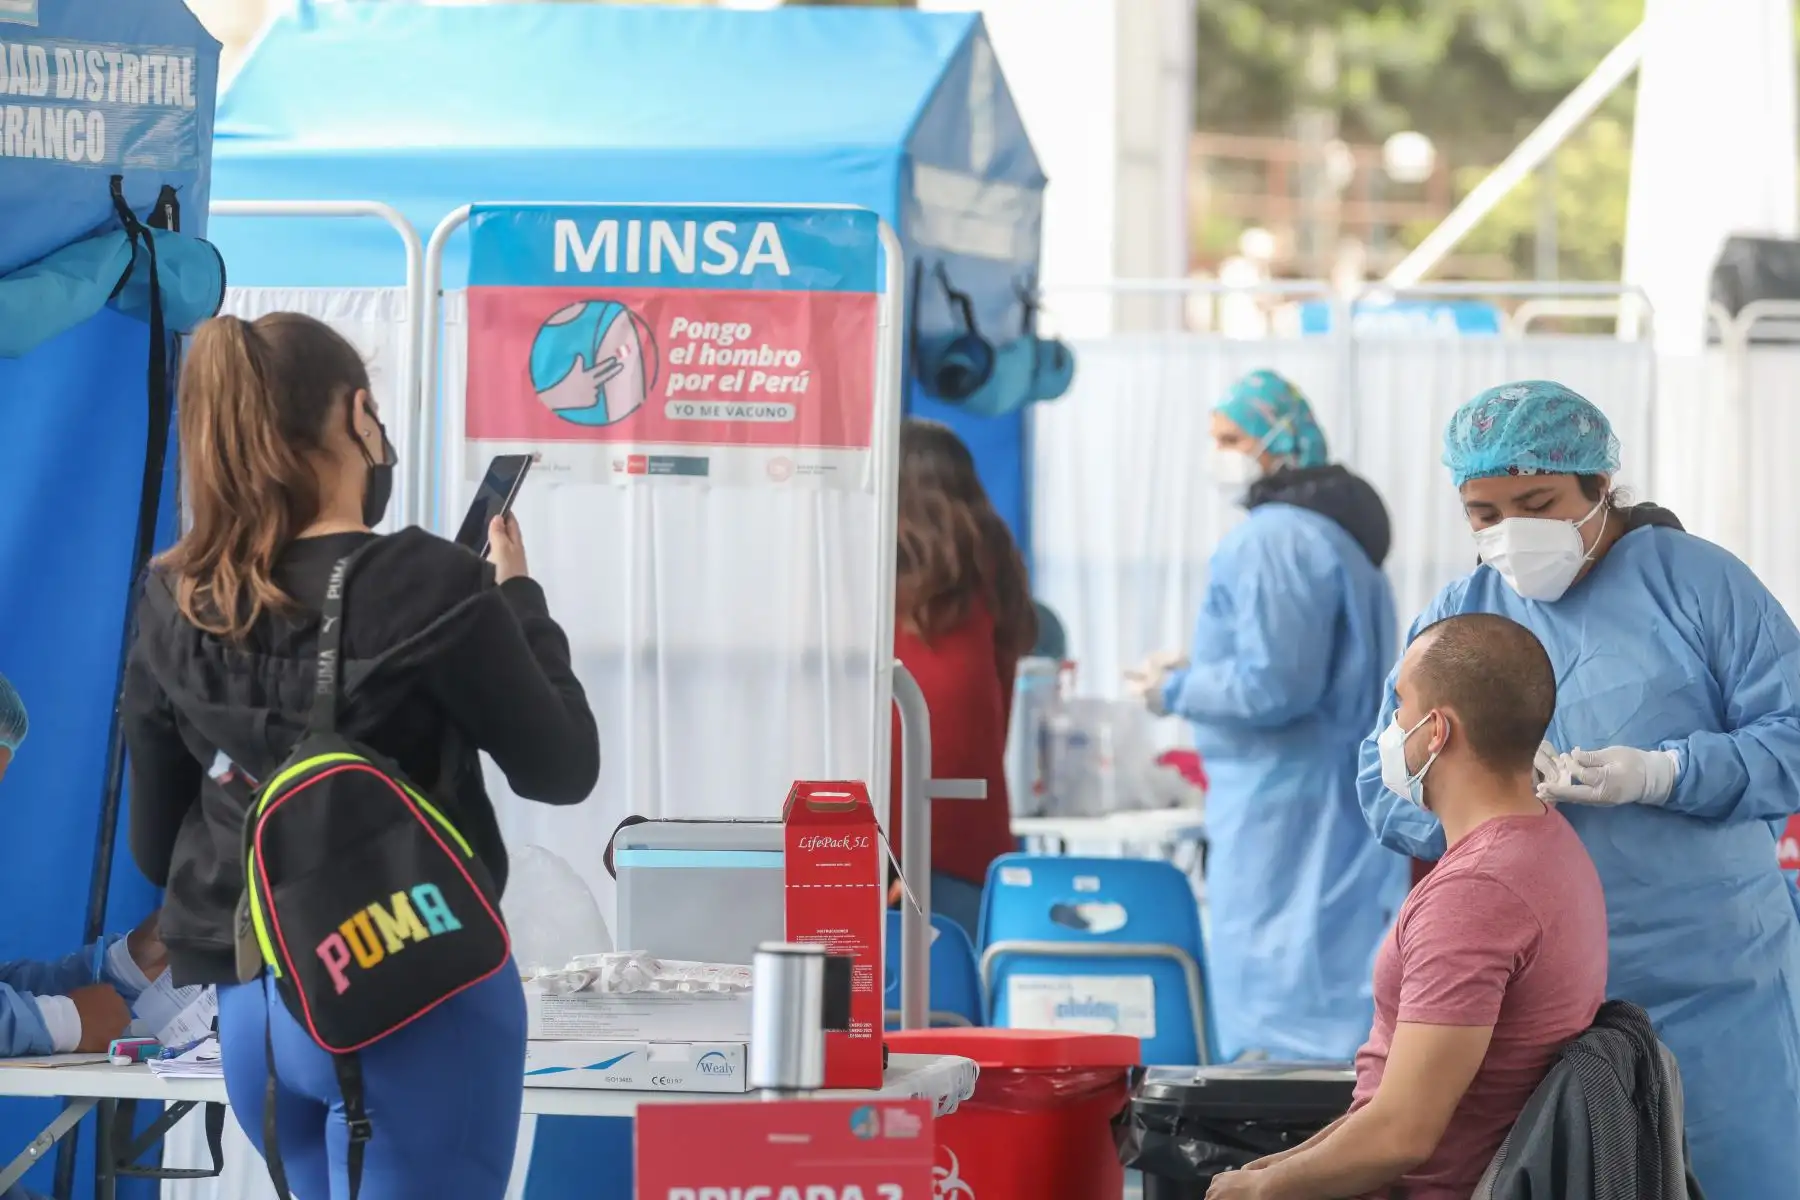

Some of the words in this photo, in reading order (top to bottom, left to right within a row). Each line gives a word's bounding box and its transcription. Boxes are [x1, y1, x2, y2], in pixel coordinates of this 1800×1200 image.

[55, 47, 196, 107] DISTRITAL
[0, 104, 105, 162] RANCO
[554, 219, 791, 276] MINSA
[669, 316, 752, 346] Pongo
[669, 342, 696, 365] el
[698, 343, 802, 368] hombro
[665, 372, 715, 397] por
[718, 369, 746, 392] el
[748, 370, 811, 394] Perú
[674, 404, 694, 416] YO
[700, 405, 720, 417] ME
[725, 406, 788, 418] VACUNO
[326, 557, 348, 599] PUMA
[316, 648, 337, 695] PUMA
[798, 835, 853, 852] LifePack
[853, 836, 869, 848] 5L
[315, 883, 463, 995] PUMA
[700, 1062, 736, 1076] Wealy
